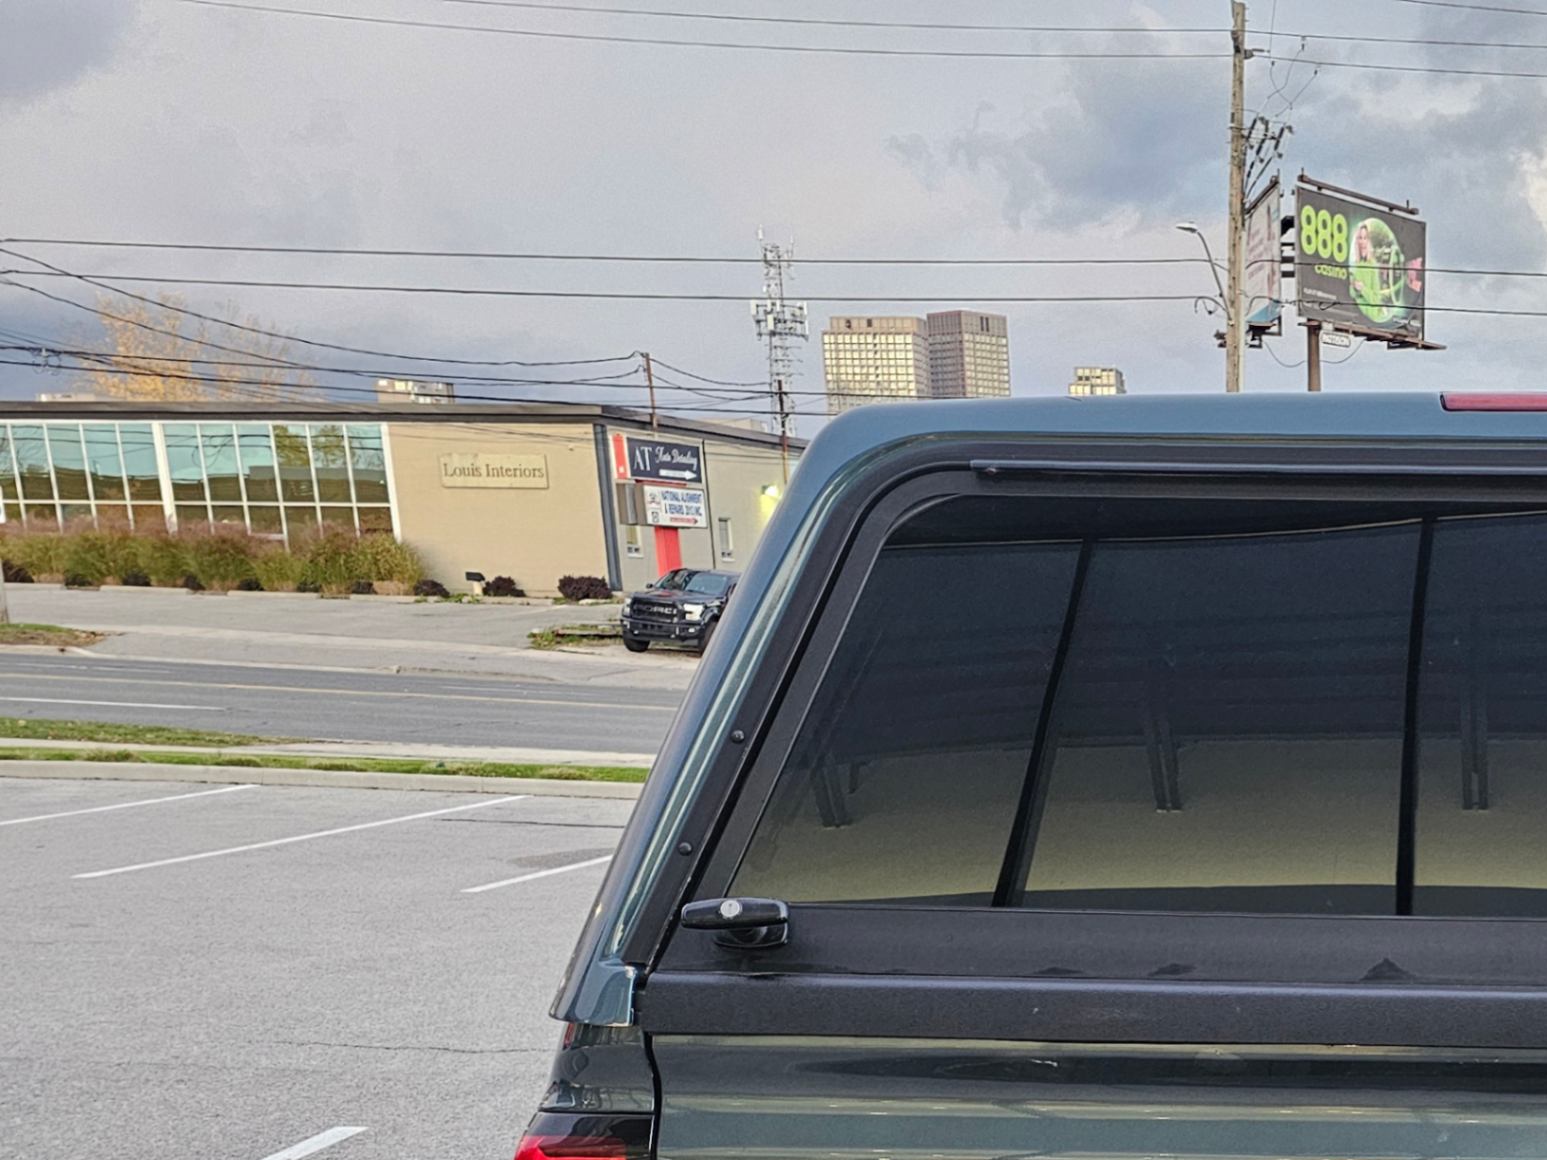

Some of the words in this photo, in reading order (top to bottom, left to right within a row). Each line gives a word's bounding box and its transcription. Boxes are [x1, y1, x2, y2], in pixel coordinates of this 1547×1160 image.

[1301, 204, 1348, 263] 888
[1315, 264, 1347, 279] casino
[633, 446, 652, 471] AT
[443, 463, 482, 477] Louis
[485, 463, 544, 478] Interiors
